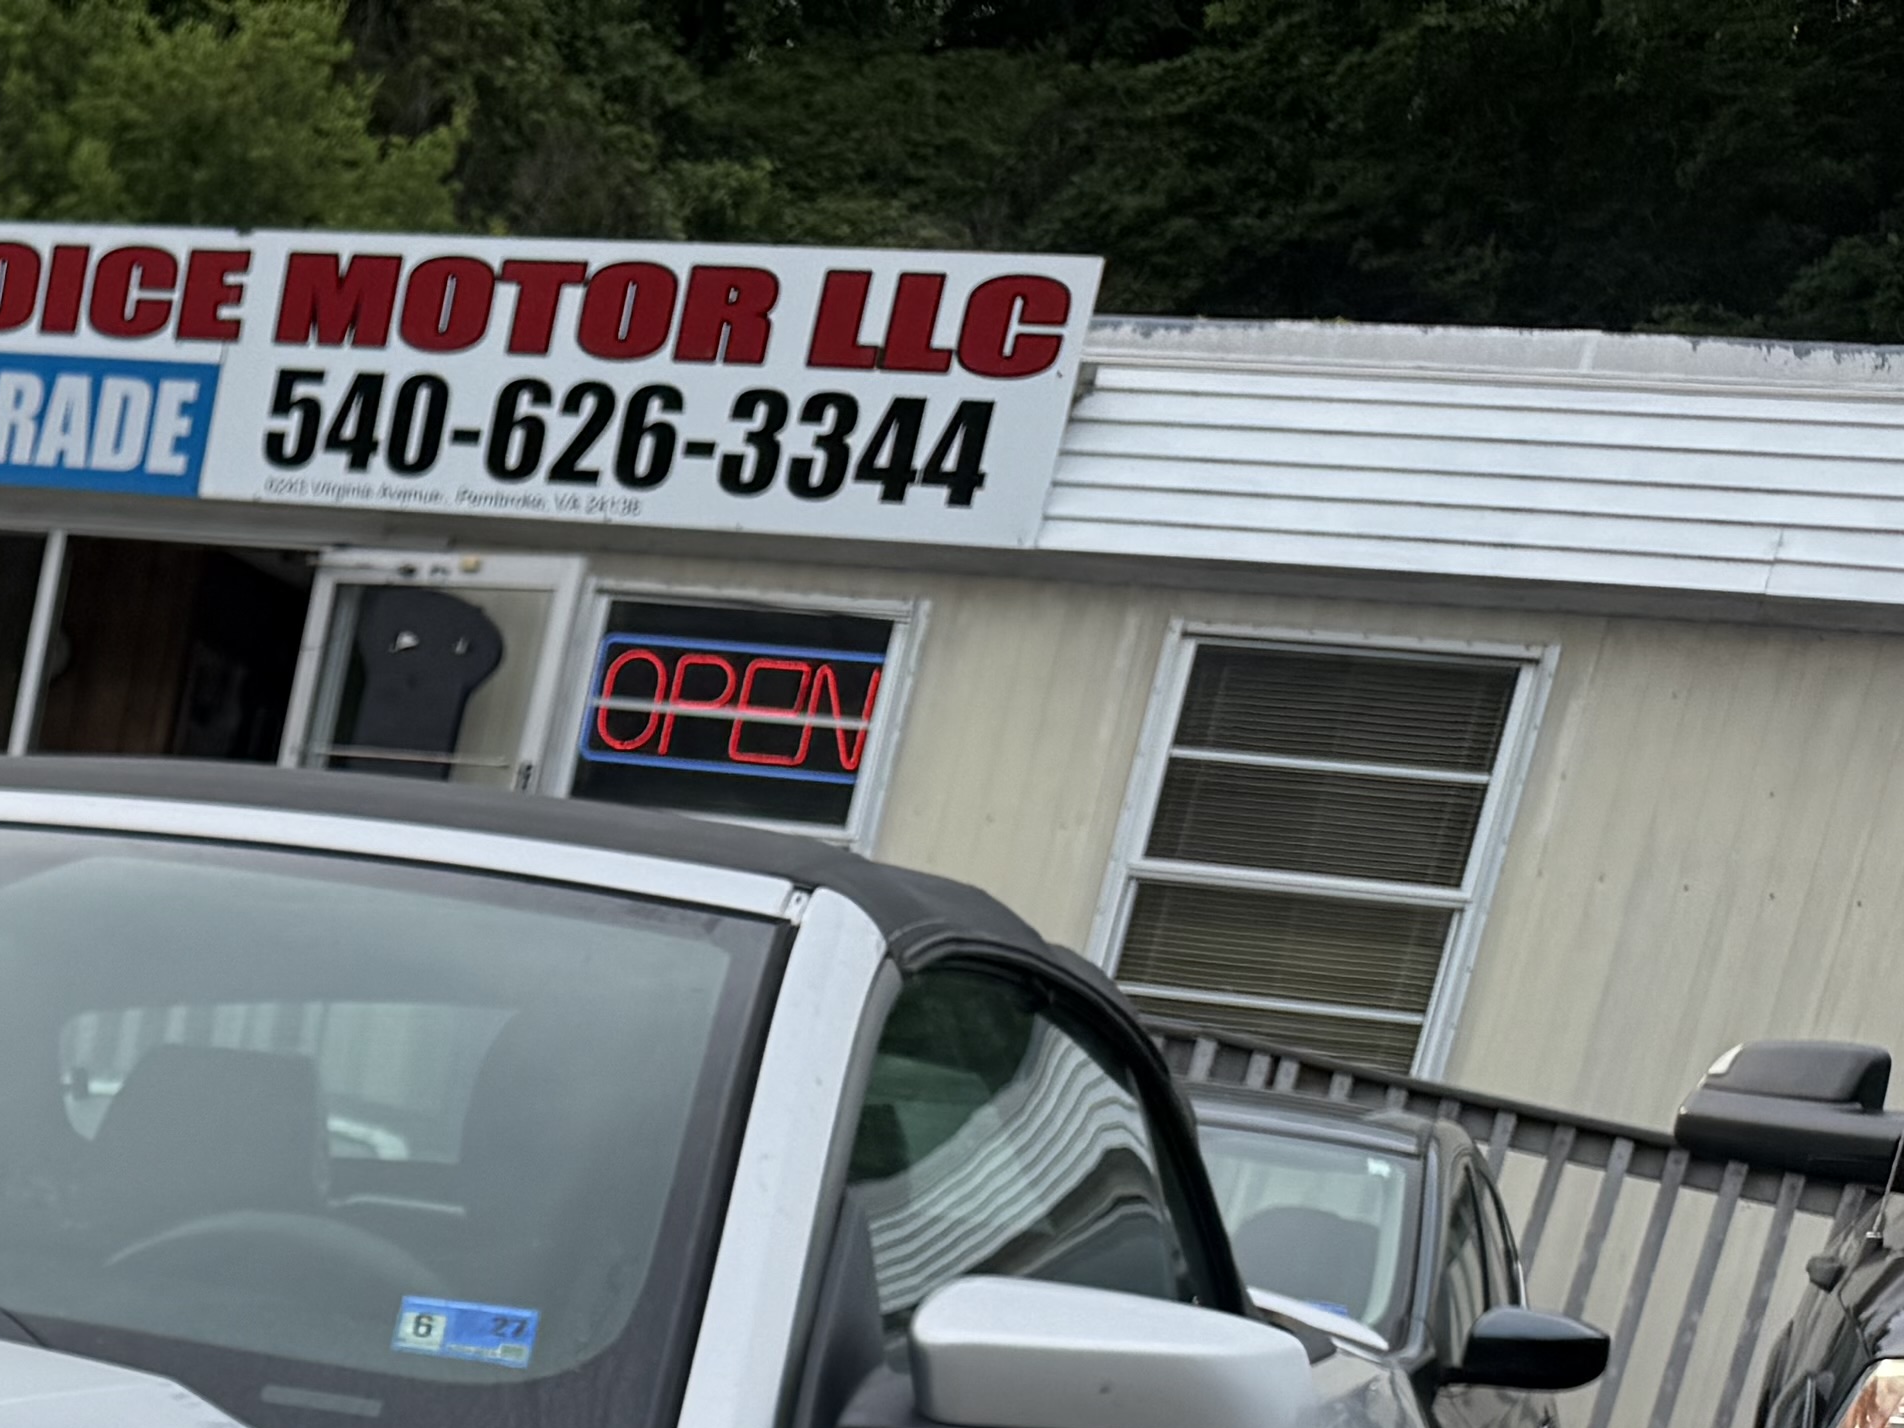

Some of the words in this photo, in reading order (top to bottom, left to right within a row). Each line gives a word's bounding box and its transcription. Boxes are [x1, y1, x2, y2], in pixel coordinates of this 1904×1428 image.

[273, 251, 780, 366] MOTOR
[807, 269, 1073, 380] LLC
[263, 368, 997, 508] 540-626-3344
[597, 649, 882, 769] OPEN
[412, 1313, 434, 1338] 6
[492, 1315, 529, 1339] 27
